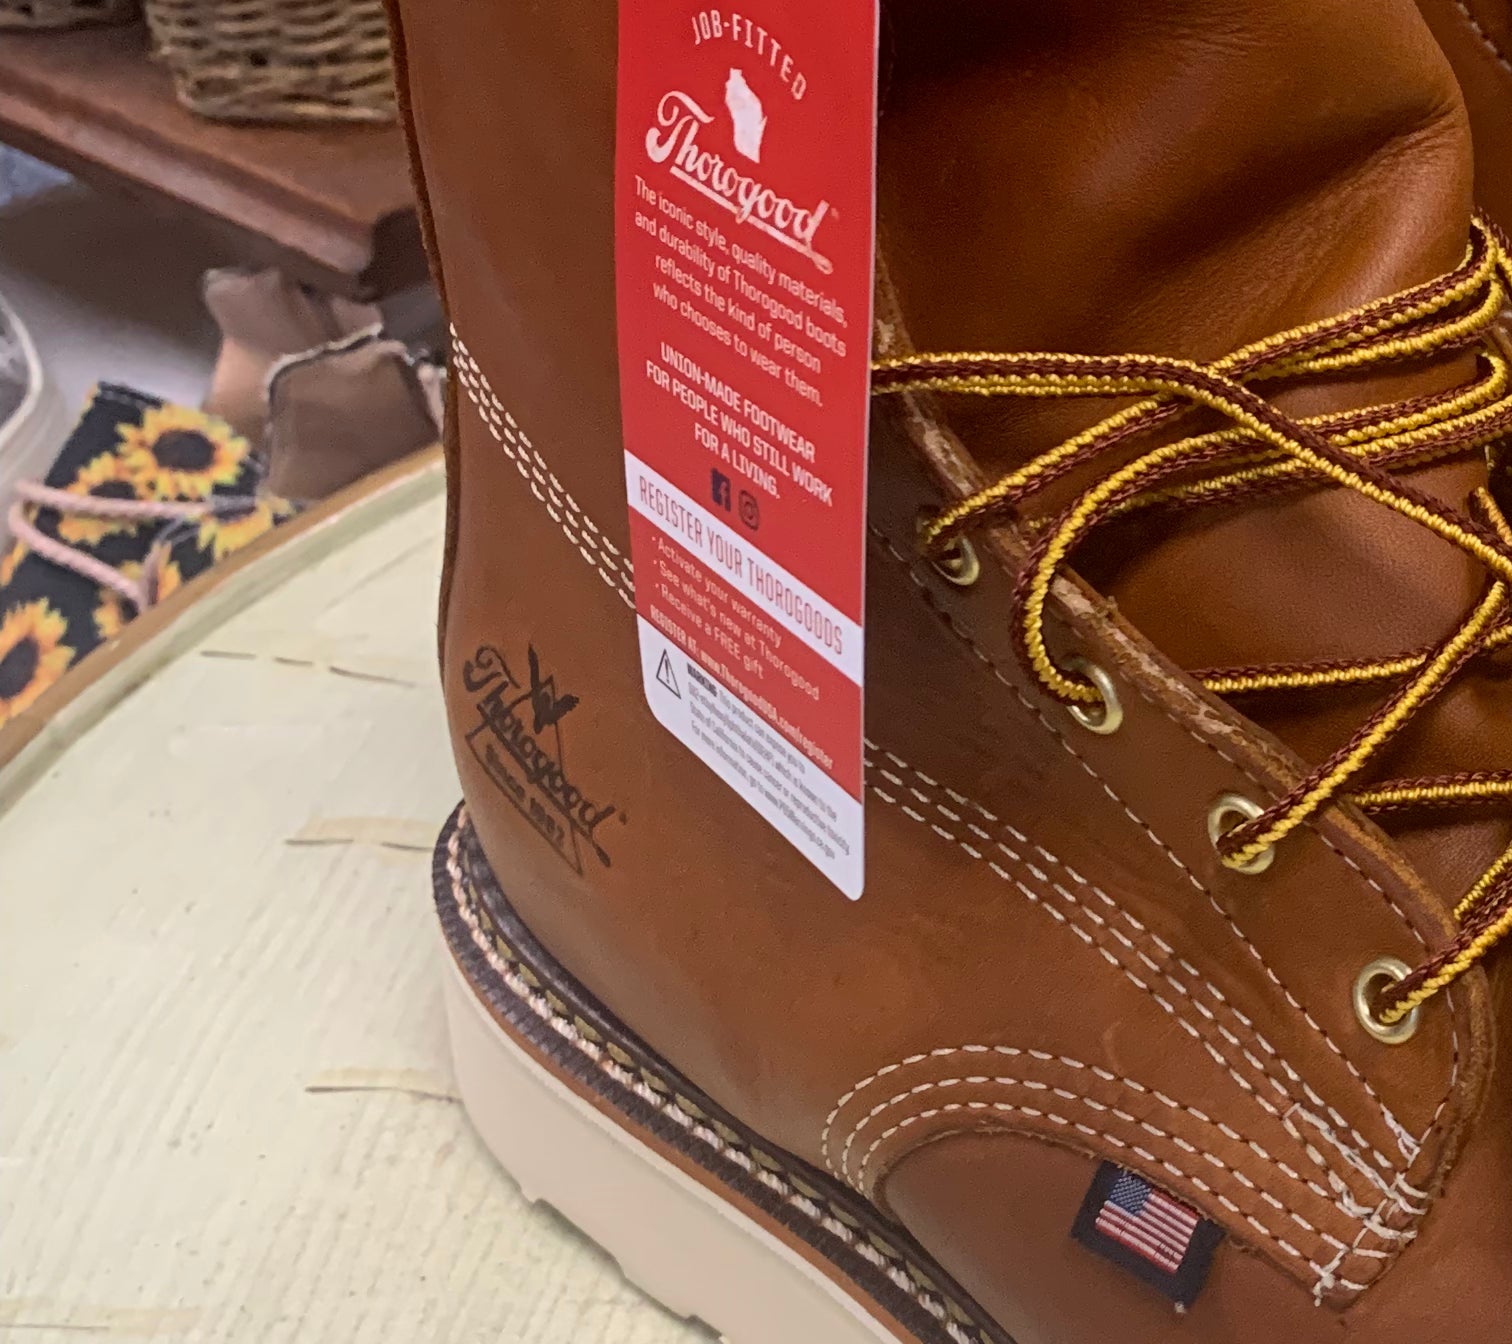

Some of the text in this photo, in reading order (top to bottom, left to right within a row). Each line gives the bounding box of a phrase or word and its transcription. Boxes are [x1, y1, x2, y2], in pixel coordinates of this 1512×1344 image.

[691, 9, 807, 101] JOB-FITTED
[646, 90, 834, 275] Thorogood
[635, 175, 847, 328] The iconic style, quality materials,
[635, 211, 846, 357] and durability of Thorogood boots
[656, 255, 821, 374] reflects the kind of person
[653, 282, 823, 407] who chooses to wear them.
[661, 341, 815, 463] UNION-MADE FOOTWEAR
[646, 360, 833, 507] FOR PEOPLE WHO STILL WORK
[695, 422, 781, 499] FOR A LIVING.
[639, 475, 843, 655] REGISTER YOUR THOROGOODS
[657, 537, 782, 649] Activate your warranty
[659, 560, 820, 701] See what's new at Thorogood
[661, 584, 765, 680] Receive a FREE gift
[463, 645, 617, 868] Thorogood
